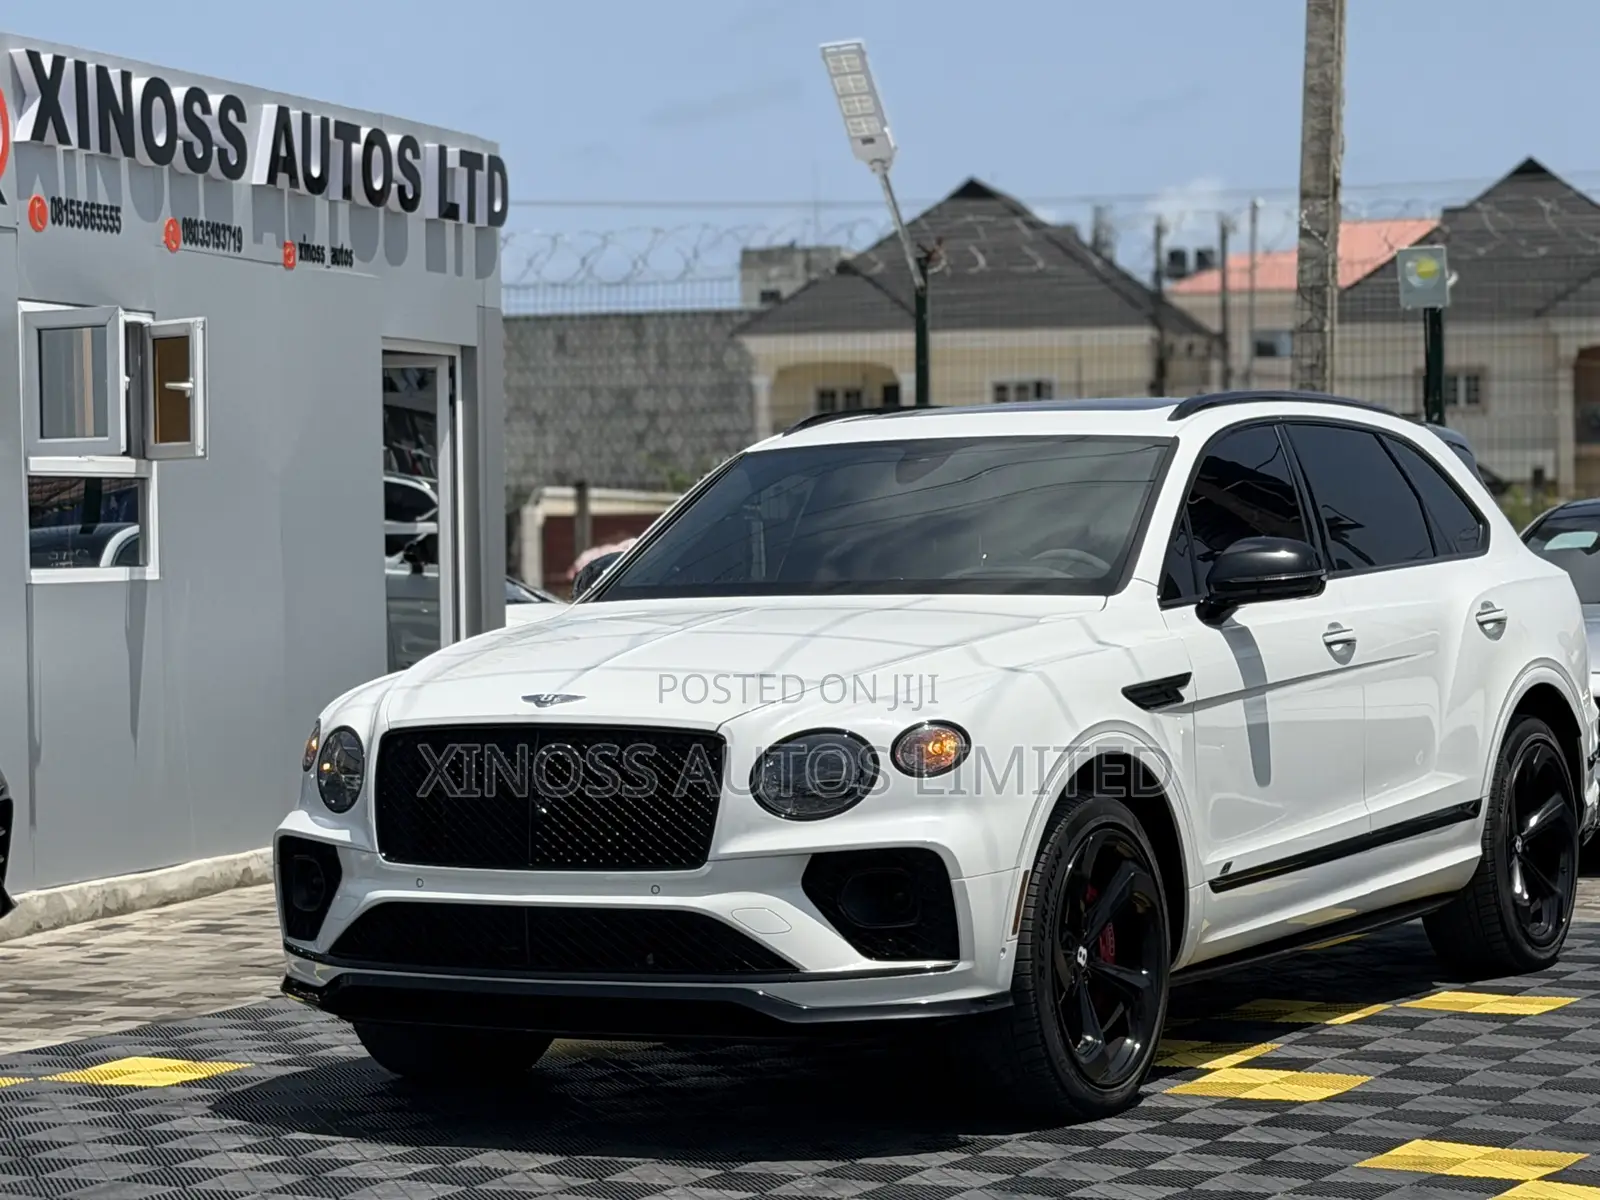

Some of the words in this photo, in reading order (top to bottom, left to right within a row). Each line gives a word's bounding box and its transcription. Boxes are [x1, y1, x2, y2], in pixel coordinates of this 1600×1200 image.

[25, 49, 248, 181] XINOSS
[267, 105, 422, 213] AUTOS
[437, 144, 508, 228] LTD
[50, 195, 122, 235] 08155665555
[182, 217, 243, 253] 08035193719
